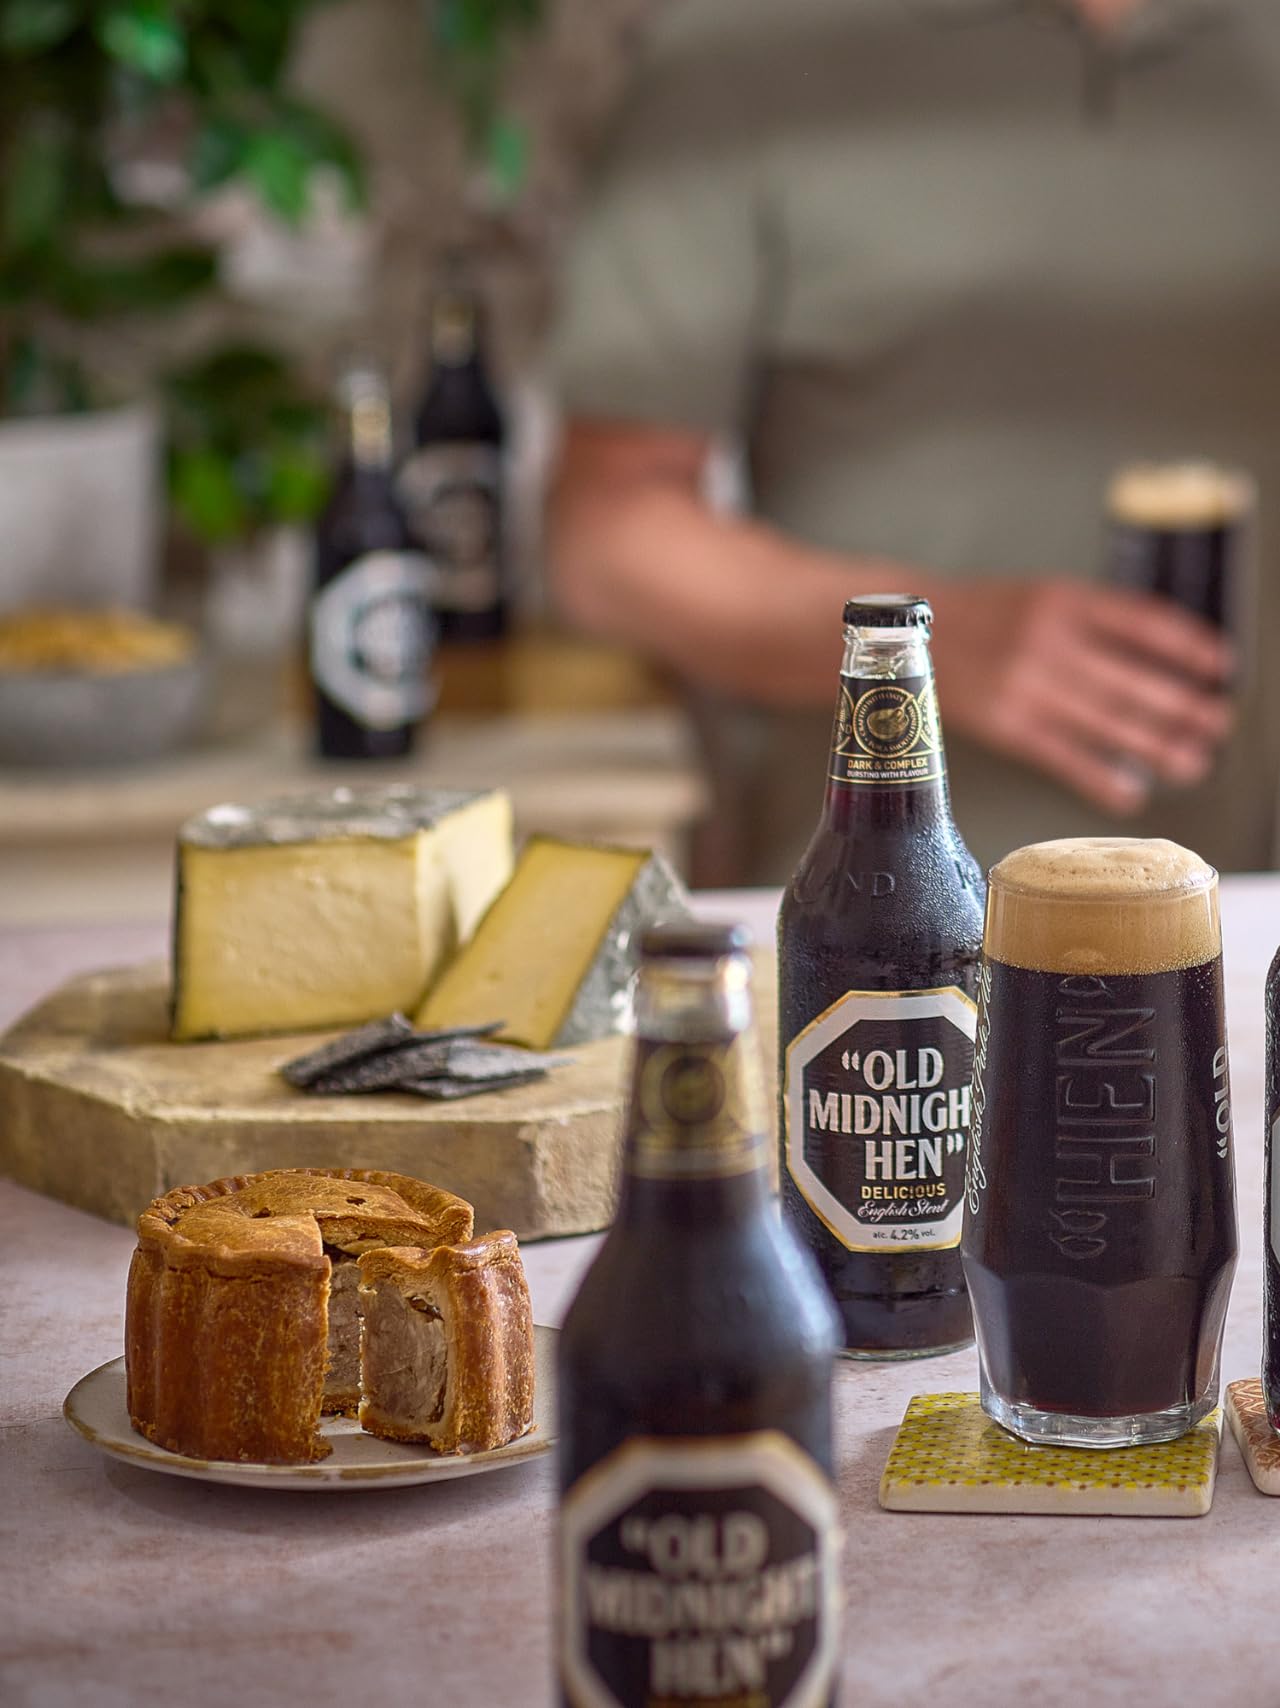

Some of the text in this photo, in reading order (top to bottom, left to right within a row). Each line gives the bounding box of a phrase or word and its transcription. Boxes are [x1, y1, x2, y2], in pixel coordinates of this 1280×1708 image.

[848, 759, 873, 770] DARK
[883, 758, 929, 770] COMPLEX
[880, 771, 899, 779] WITH
[841, 1048, 944, 1091] “OLD
[966, 965, 992, 1215] English Pale Ale
[808, 1085, 972, 1135] MIDNIGH
[864, 1133, 965, 1181] HEN”
[861, 1183, 947, 1200] DELICIOUS
[857, 1201, 908, 1223] English
[890, 1228, 920, 1240] 4.2%
